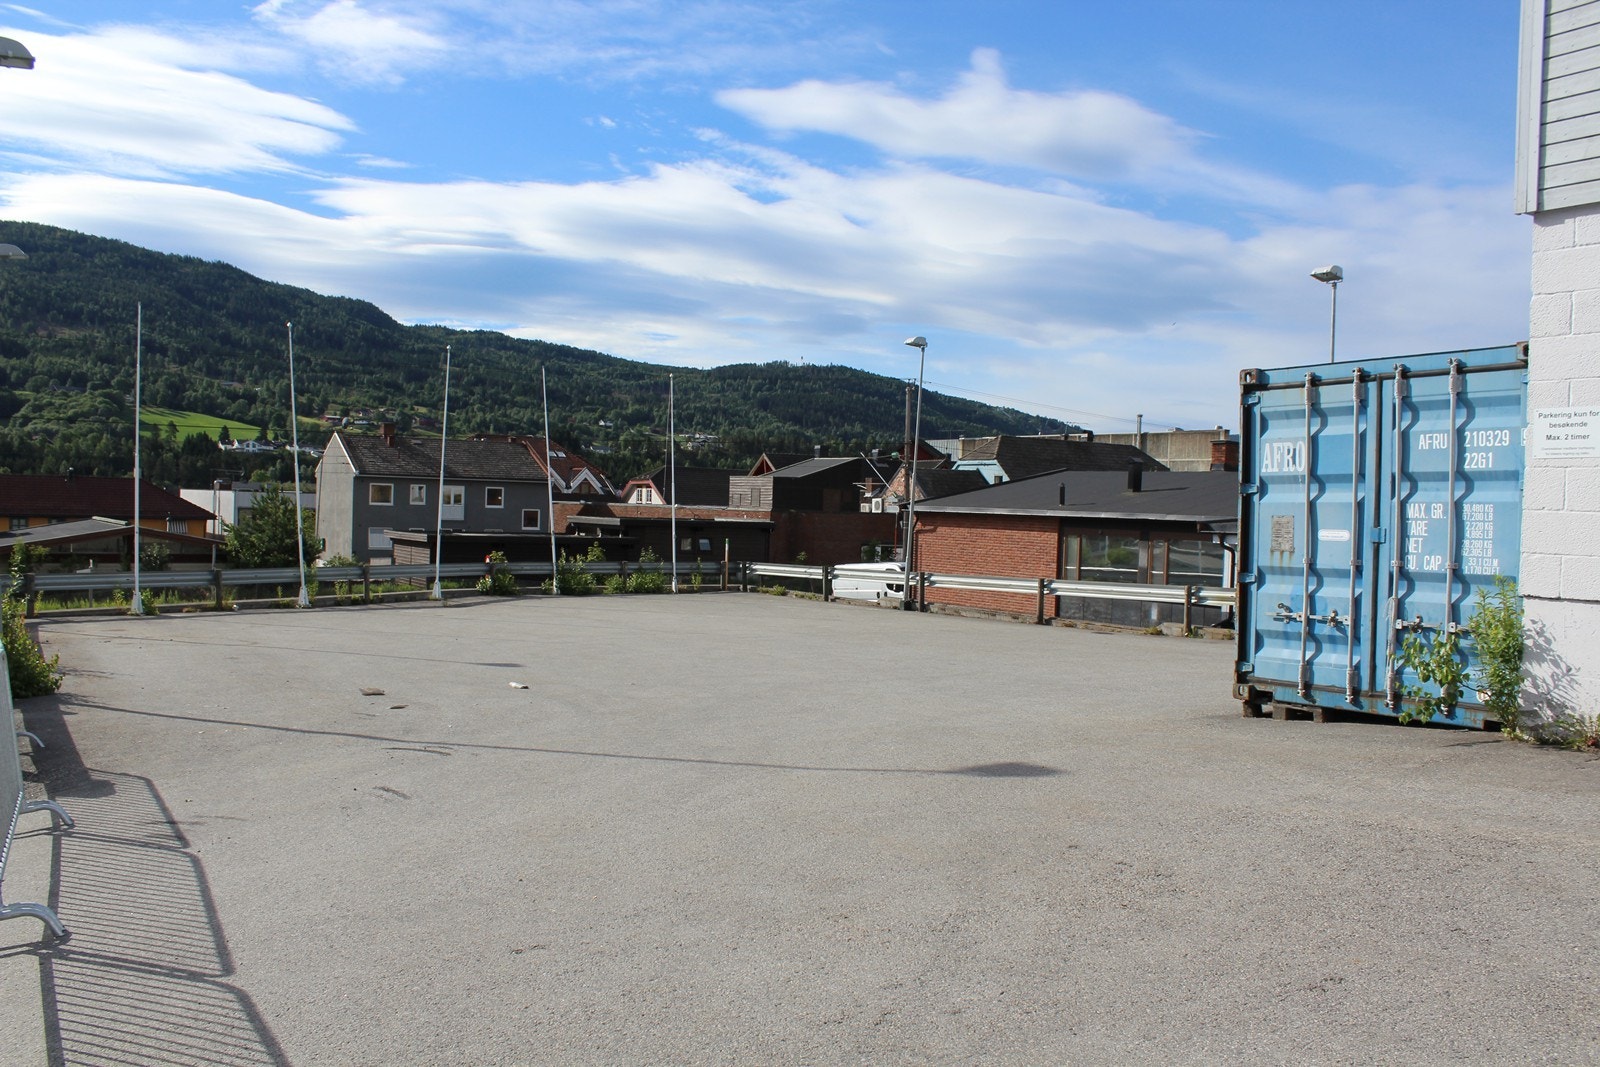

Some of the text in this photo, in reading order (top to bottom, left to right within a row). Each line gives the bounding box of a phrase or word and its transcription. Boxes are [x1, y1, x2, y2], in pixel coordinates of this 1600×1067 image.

[1418, 433, 1448, 450] AFRU
[1463, 429, 1510, 447] 210329
[1261, 440, 1306, 473] AFRO
[1463, 452, 1493, 469] 22G1
[1406, 503, 1447, 519] MAX. GR.
[1485, 504, 1494, 513] KG
[1485, 512, 1493, 521] LB
[1406, 520, 1428, 536] TARE
[1485, 522, 1493, 531] KG
[1485, 530, 1493, 539] LB
[1405, 537, 1423, 553] NET
[1484, 540, 1493, 549] KG
[1484, 548, 1492, 557] LB
[1404, 554, 1445, 571] CU. CAP.
